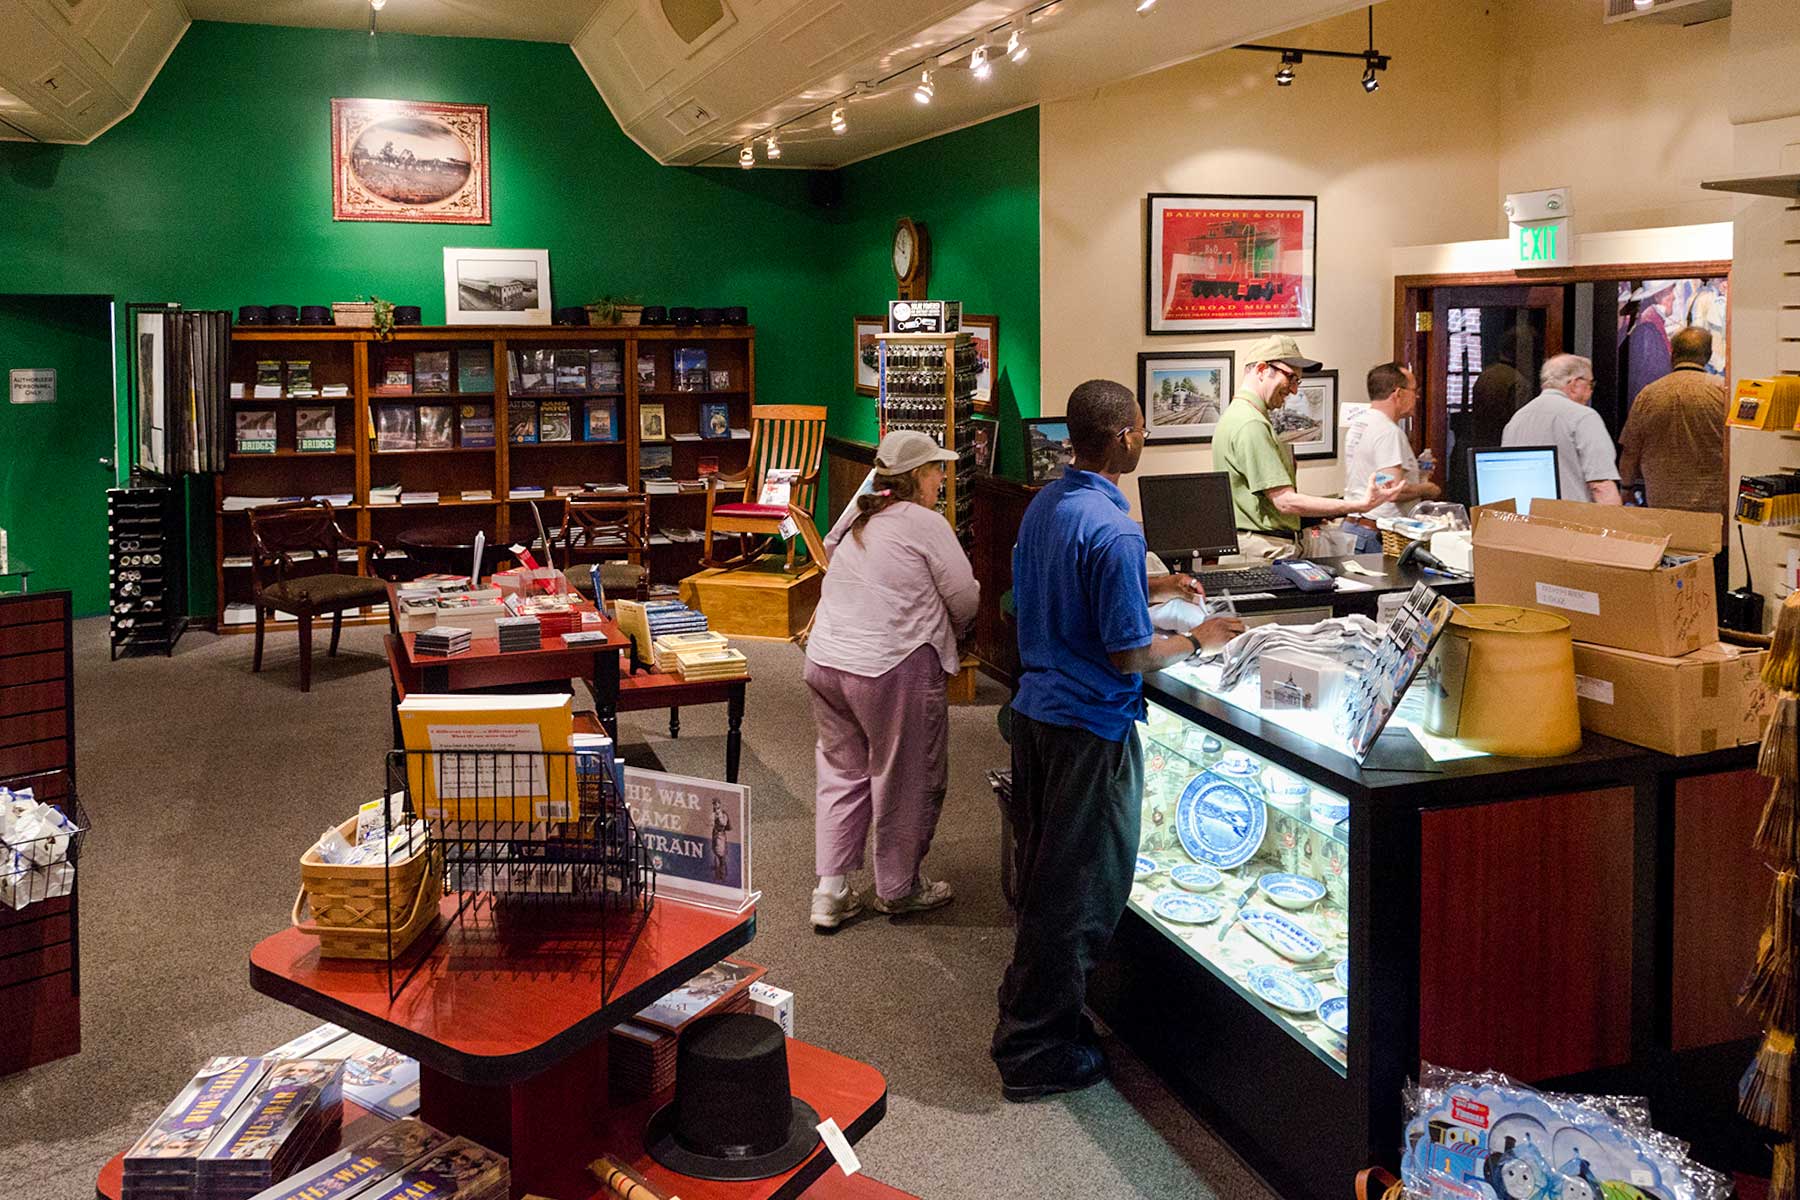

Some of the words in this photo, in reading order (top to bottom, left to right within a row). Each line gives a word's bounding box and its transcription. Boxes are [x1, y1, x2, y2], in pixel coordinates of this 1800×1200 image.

[1265, 211, 1301, 219] OHIO
[1520, 225, 1559, 261] EXIT
[1244, 303, 1299, 311] MUSEUM
[241, 441, 274, 451] BRIDGES
[302, 439, 335, 449] BRIDGES
[625, 783, 652, 804] THE
[659, 788, 701, 811] WAR
[630, 807, 682, 831] CAME
[644, 833, 704, 859] TRAIN
[182, 1098, 222, 1124] WAR
[260, 1090, 299, 1116] WAR
[333, 1156, 381, 1183] WAR
